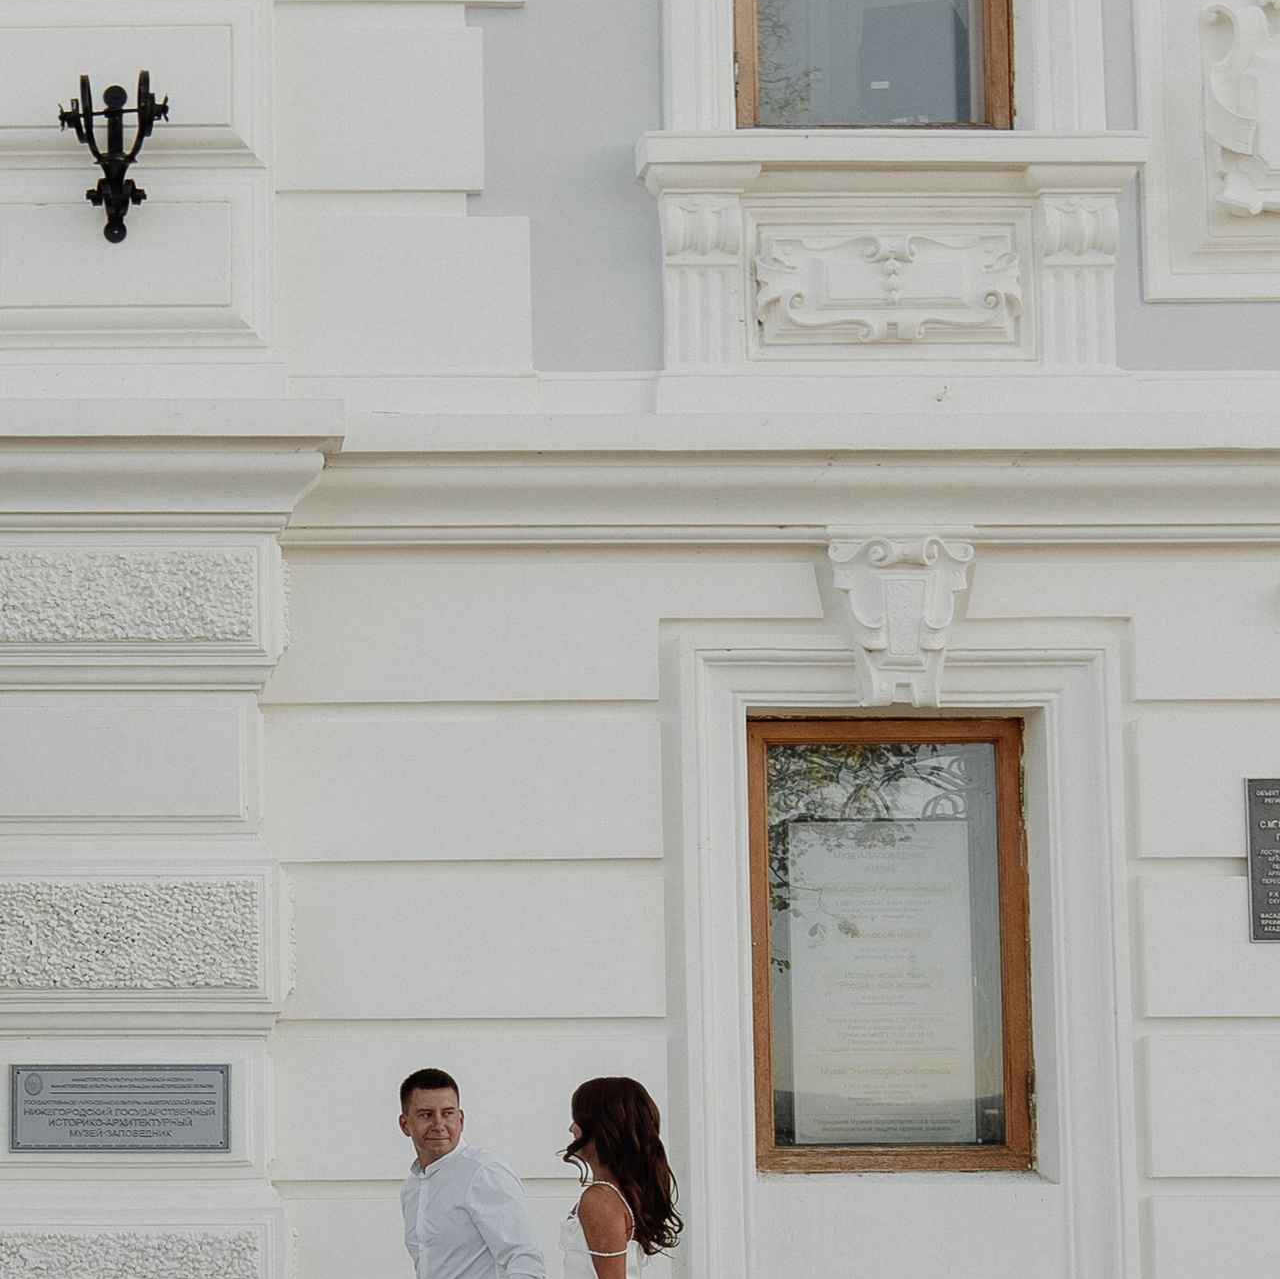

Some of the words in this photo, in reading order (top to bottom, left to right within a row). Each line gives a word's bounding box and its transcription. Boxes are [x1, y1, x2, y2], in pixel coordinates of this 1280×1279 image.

[24, 1107, 113, 1117] НИЖЕГОРОДСКИЙ
[115, 1107, 216, 1117] ГОСУДАРСТВЕННЫЙ
[49, 1117, 193, 1127] ИСТОРИКО-АРХИТЕКТУРНЫЙ
[69, 1128, 172, 1138] МУЗЕЙ-ЗАПОВЕДНИК
